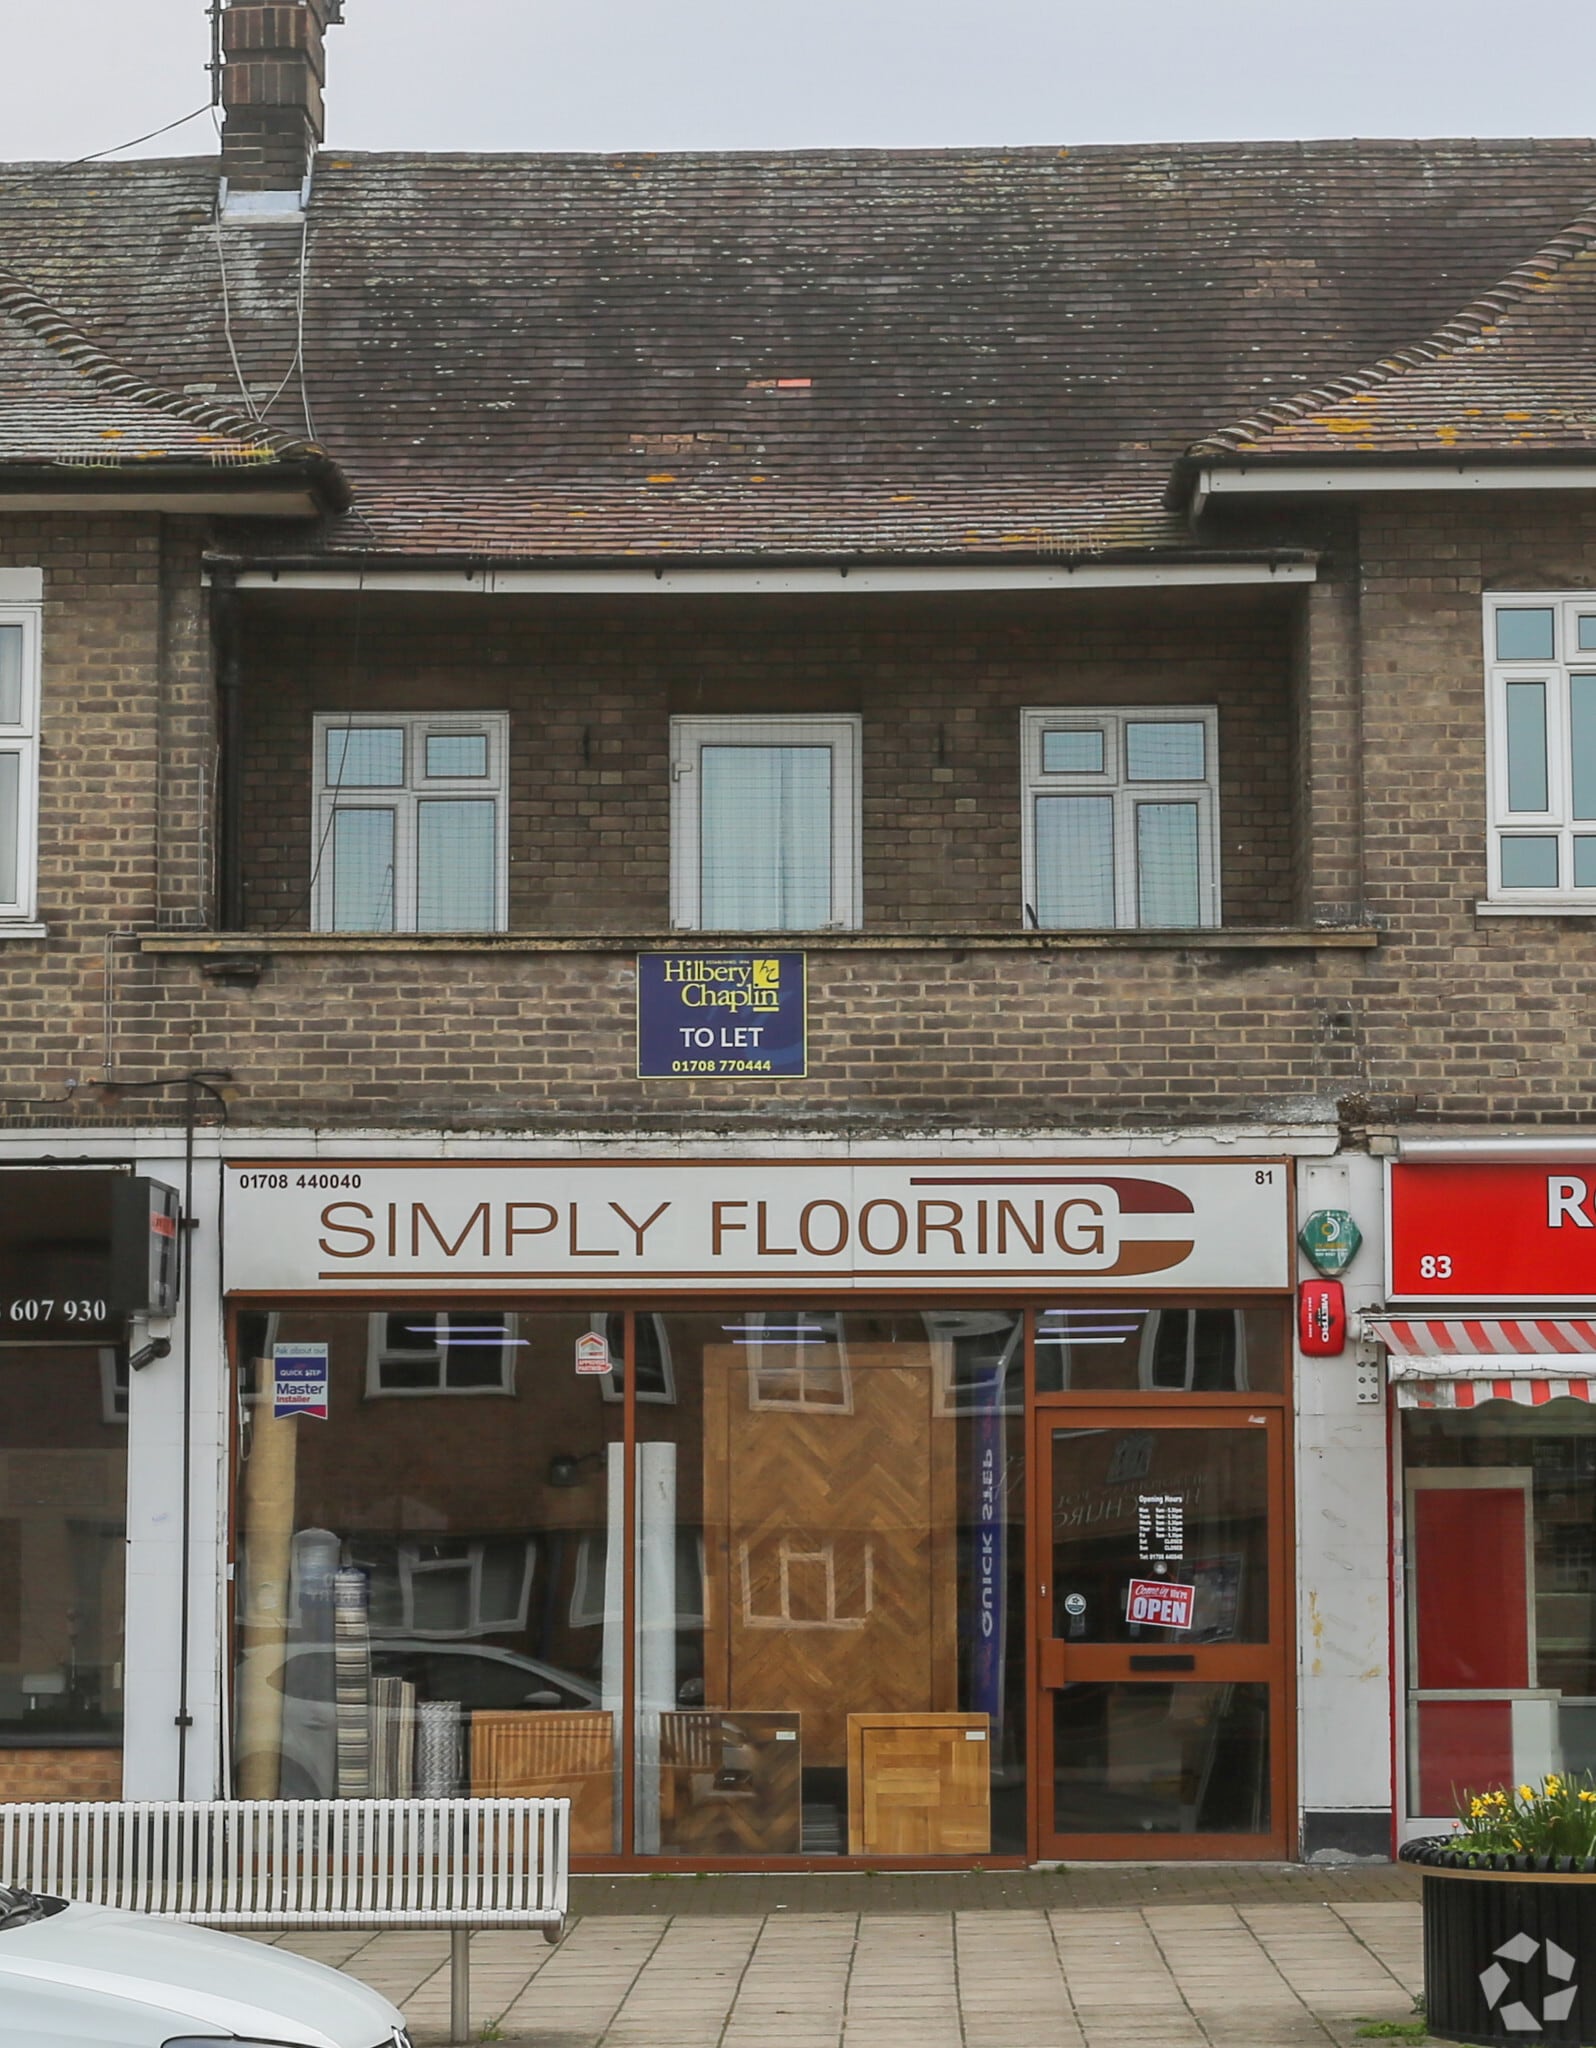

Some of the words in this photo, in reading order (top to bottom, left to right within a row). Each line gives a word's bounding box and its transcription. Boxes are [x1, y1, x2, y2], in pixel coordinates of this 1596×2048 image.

[664, 959, 751, 987] Hilbery
[681, 983, 779, 1013] Chaplin
[680, 1027, 714, 1047] TO
[721, 1027, 764, 1047] LET
[672, 1060, 715, 1072] 01708
[720, 1060, 771, 1072] 770444
[239, 1174, 288, 1189] 01708
[296, 1174, 362, 1189] 440040
[1255, 1170, 1274, 1185] 81
[318, 1201, 672, 1258] SIMPLY
[710, 1198, 1106, 1255] FLOORING
[1420, 1254, 1453, 1279] 83
[10, 1300, 54, 1321] 607
[63, 1300, 107, 1321] 930
[1320, 1293, 1330, 1343] METRO
[276, 1383, 324, 1395] Master
[276, 1395, 311, 1403] Installer
[1138, 1494, 1163, 1504] Opening
[1164, 1495, 1183, 1504] Hours
[1133, 1596, 1187, 1623] OPEN
